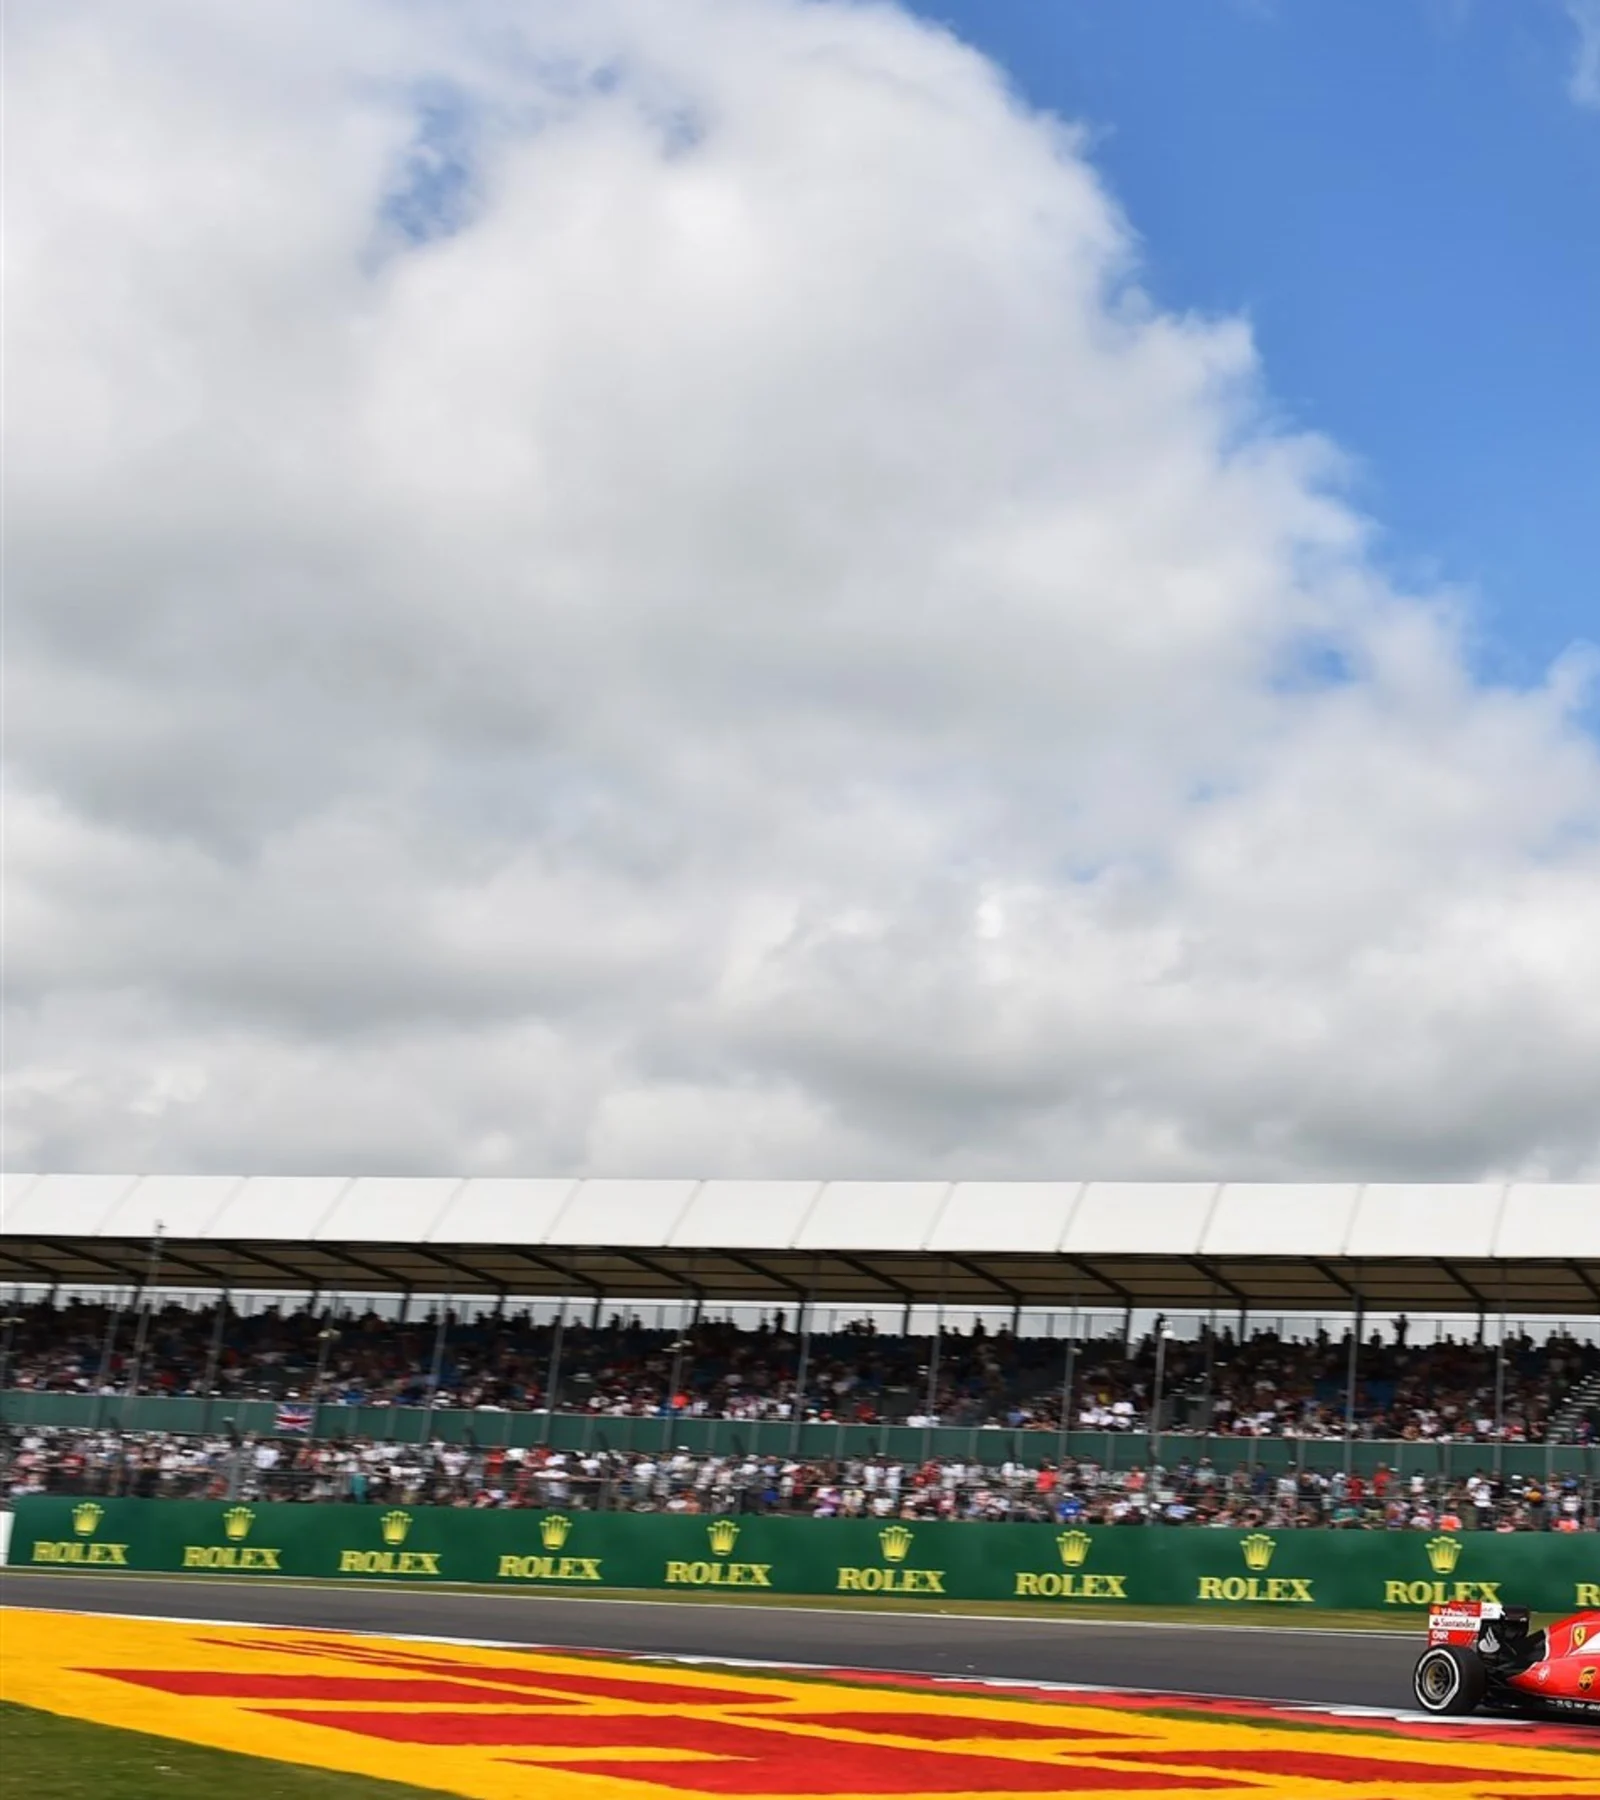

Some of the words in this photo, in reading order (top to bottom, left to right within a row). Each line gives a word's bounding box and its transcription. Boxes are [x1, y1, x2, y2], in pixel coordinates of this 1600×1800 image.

[32, 1541, 128, 1565] ROLEX
[183, 1546, 281, 1570] ROLEX
[339, 1550, 440, 1575] ROLEX
[498, 1555, 602, 1580] ROLEX
[665, 1561, 771, 1586] ROLEX
[836, 1567, 944, 1593] ROLEX
[1015, 1572, 1127, 1598] ROLEX
[1199, 1576, 1313, 1602] ROLEX
[1385, 1580, 1501, 1604] ROLEX
[1440, 1616, 1476, 1629] Santander
